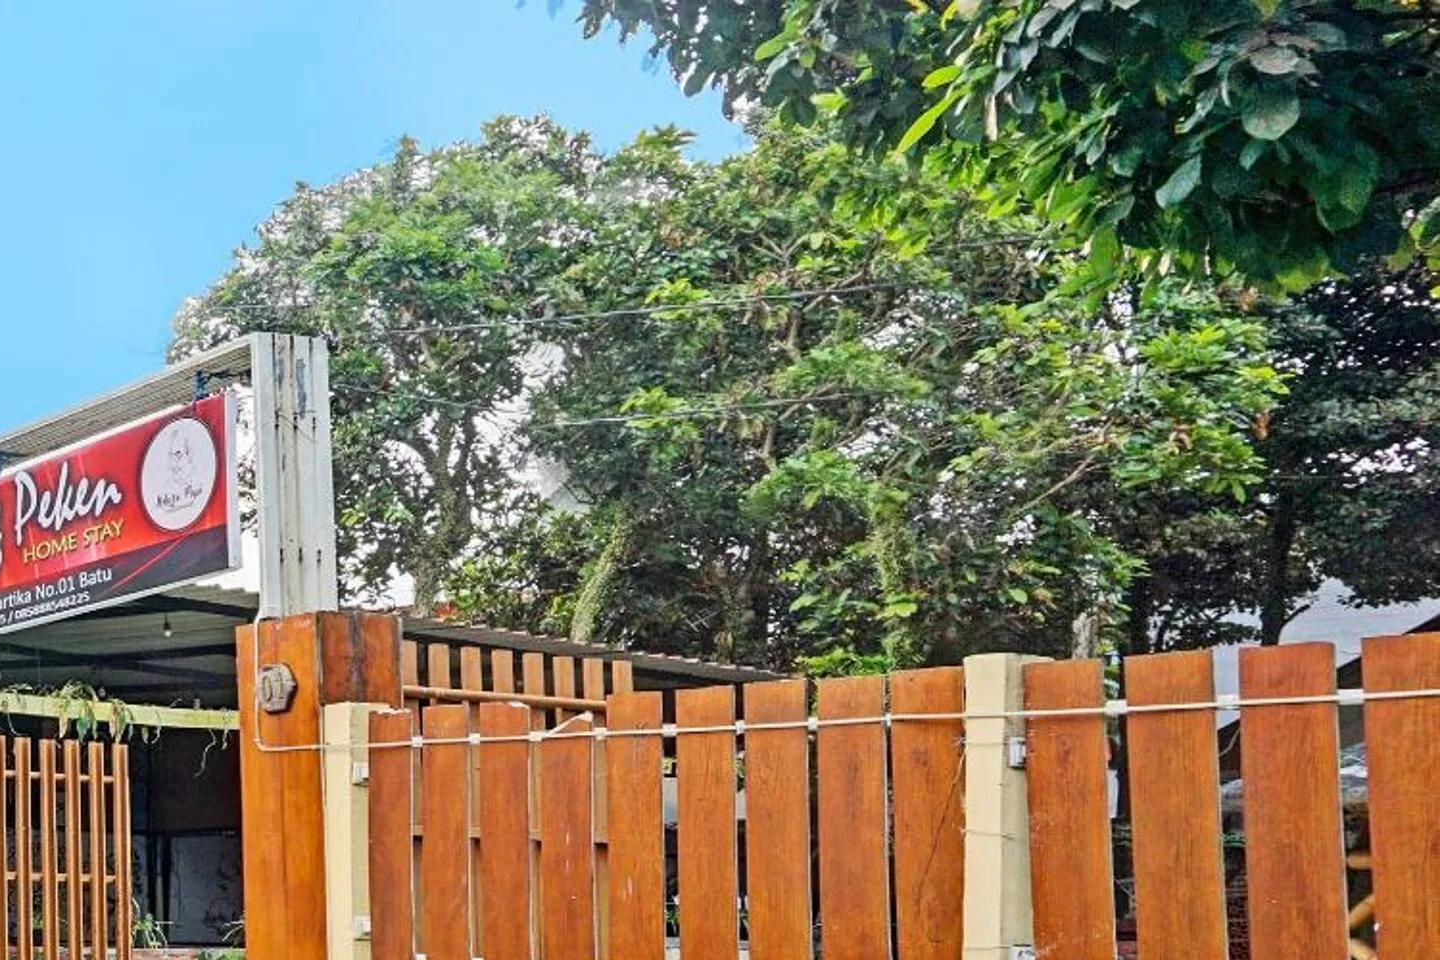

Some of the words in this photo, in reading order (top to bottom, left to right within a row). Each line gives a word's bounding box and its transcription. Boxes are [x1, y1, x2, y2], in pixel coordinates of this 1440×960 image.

[14, 461, 122, 546] Peken
[23, 531, 79, 564] HOME
[83, 519, 125, 550] STAY
[35, 577, 75, 599] No.01
[79, 568, 113, 588] Batu
